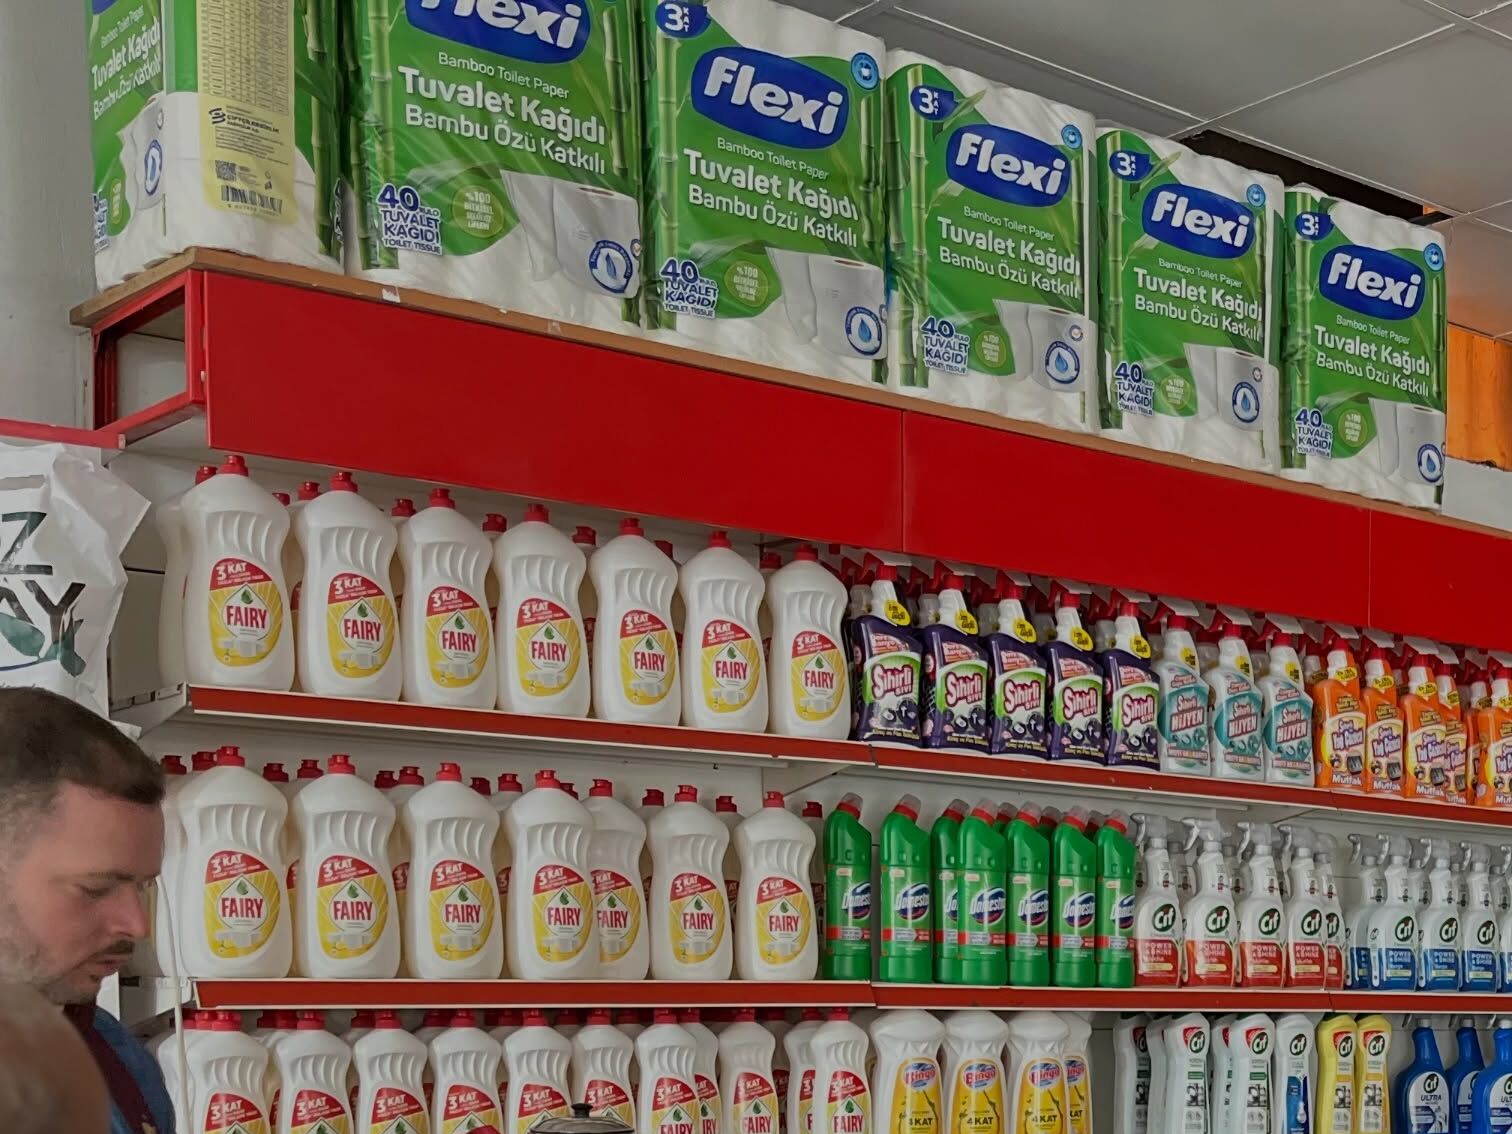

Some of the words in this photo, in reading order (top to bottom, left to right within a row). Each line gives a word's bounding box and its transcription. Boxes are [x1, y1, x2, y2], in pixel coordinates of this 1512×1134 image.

[420, 0, 582, 49] exi
[664, 4, 684, 31] 3
[438, 52, 495, 76] Bamboo
[497, 66, 531, 87] Toilet
[534, 79, 569, 99] Paper
[398, 66, 515, 117] Tuvalet
[521, 96, 605, 145] Kağıdı
[704, 56, 843, 135] Flexi
[918, 88, 934, 113] 3
[406, 104, 488, 141] Bambu
[494, 119, 536, 152] Özü
[541, 137, 605, 174] Katkılı
[718, 137, 764, 160] Bamboo
[767, 151, 797, 170] Toilet
[799, 161, 829, 180] Paper
[956, 132, 1065, 195] Flexi
[1116, 152, 1131, 176] 3
[683, 148, 781, 199] Tuvalet
[788, 178, 858, 220] Kağıdı
[377, 184, 419, 212] 40
[381, 209, 440, 229] TUVALET
[689, 184, 758, 220] Bambu
[763, 200, 798, 231] Özü
[803, 215, 857, 248] Katkılı
[964, 206, 1001, 226] Bamboo
[1003, 217, 1027, 233] Toilet
[1029, 225, 1055, 241] Paper
[1151, 190, 1250, 247] Flexi
[1301, 214, 1315, 235] 3
[937, 216, 1015, 258] Tuvalet
[1021, 240, 1080, 276] Kağıdı
[660, 259, 699, 283] 40
[940, 246, 995, 275] Bambu
[999, 259, 1027, 285] Özü
[1031, 271, 1079, 298] Katkılı
[1328, 252, 1421, 308] Flexi
[665, 279, 718, 298] TUVALET
[1134, 267, 1207, 304] Tuvalet
[1211, 288, 1262, 321] Kağıdı
[921, 316, 954, 338] 40
[1135, 294, 1187, 320] Bambu
[1191, 304, 1218, 328] Özü
[1222, 315, 1260, 342] Katkılı
[1336, 314, 1367, 332] Bamboo
[1369, 323, 1388, 338] Toilet
[1390, 331, 1410, 345] Paper
[924, 336, 969, 351] TUVALET
[1314, 325, 1377, 361] Tuvalet
[1381, 346, 1430, 376] Kağıdı
[1115, 362, 1142, 383] 40
[1316, 352, 1363, 377] Bambu
[1366, 362, 1389, 384] Özü
[1392, 373, 1429, 397] Katkılı
[1295, 408, 1322, 428] 40
[216, 566, 227, 580] 3
[228, 563, 247, 573] KAT
[226, 606, 267, 629] FAIRY
[343, 617, 382, 644] FAIRY
[441, 629, 478, 654] FAIRY
[531, 640, 567, 662] FAIRY
[634, 651, 665, 673] FAIRY
[715, 660, 748, 680] FAIRY
[804, 669, 835, 689] FAIRY
[211, 858, 222, 873] 3
[222, 852, 242, 868] KAT
[221, 897, 264, 919] FAIRY
[333, 900, 373, 921] FAIRY
[444, 904, 481, 924] FAIRY
[547, 906, 581, 927] FAIRY
[1154, 908, 1174, 928] Cif
[597, 909, 629, 929] FAIRY
[682, 912, 714, 931] FAIRY
[768, 915, 800, 933] FAIRY
[1207, 909, 1228, 930] Cif
[1260, 913, 1279, 932] Cif
[1302, 913, 1321, 932] Cif
[1396, 920, 1413, 939] Cif
[1441, 922, 1458, 940] Cif
[1479, 924, 1493, 942] Cif
[1191, 1033, 1205, 1052] Cif
[1253, 1034, 1268, 1052] Cif
[1291, 1036, 1306, 1054] Cif
[1340, 1037, 1353, 1055] Cif
[1369, 1036, 1385, 1054] Cif
[904, 1066, 937, 1085] Bingo
[964, 1066, 998, 1085] Bingo
[1029, 1064, 1061, 1084] Bingo
[1424, 1076, 1438, 1093] Cif
[1420, 1094, 1442, 1102] ULTRA
[211, 1106, 220, 1120] 3
[224, 1100, 242, 1112] KAT
[741, 1115, 772, 1134] FAIRY
[833, 1114, 864, 1133] FAIRY
[975, 1116, 993, 1126] KAT
